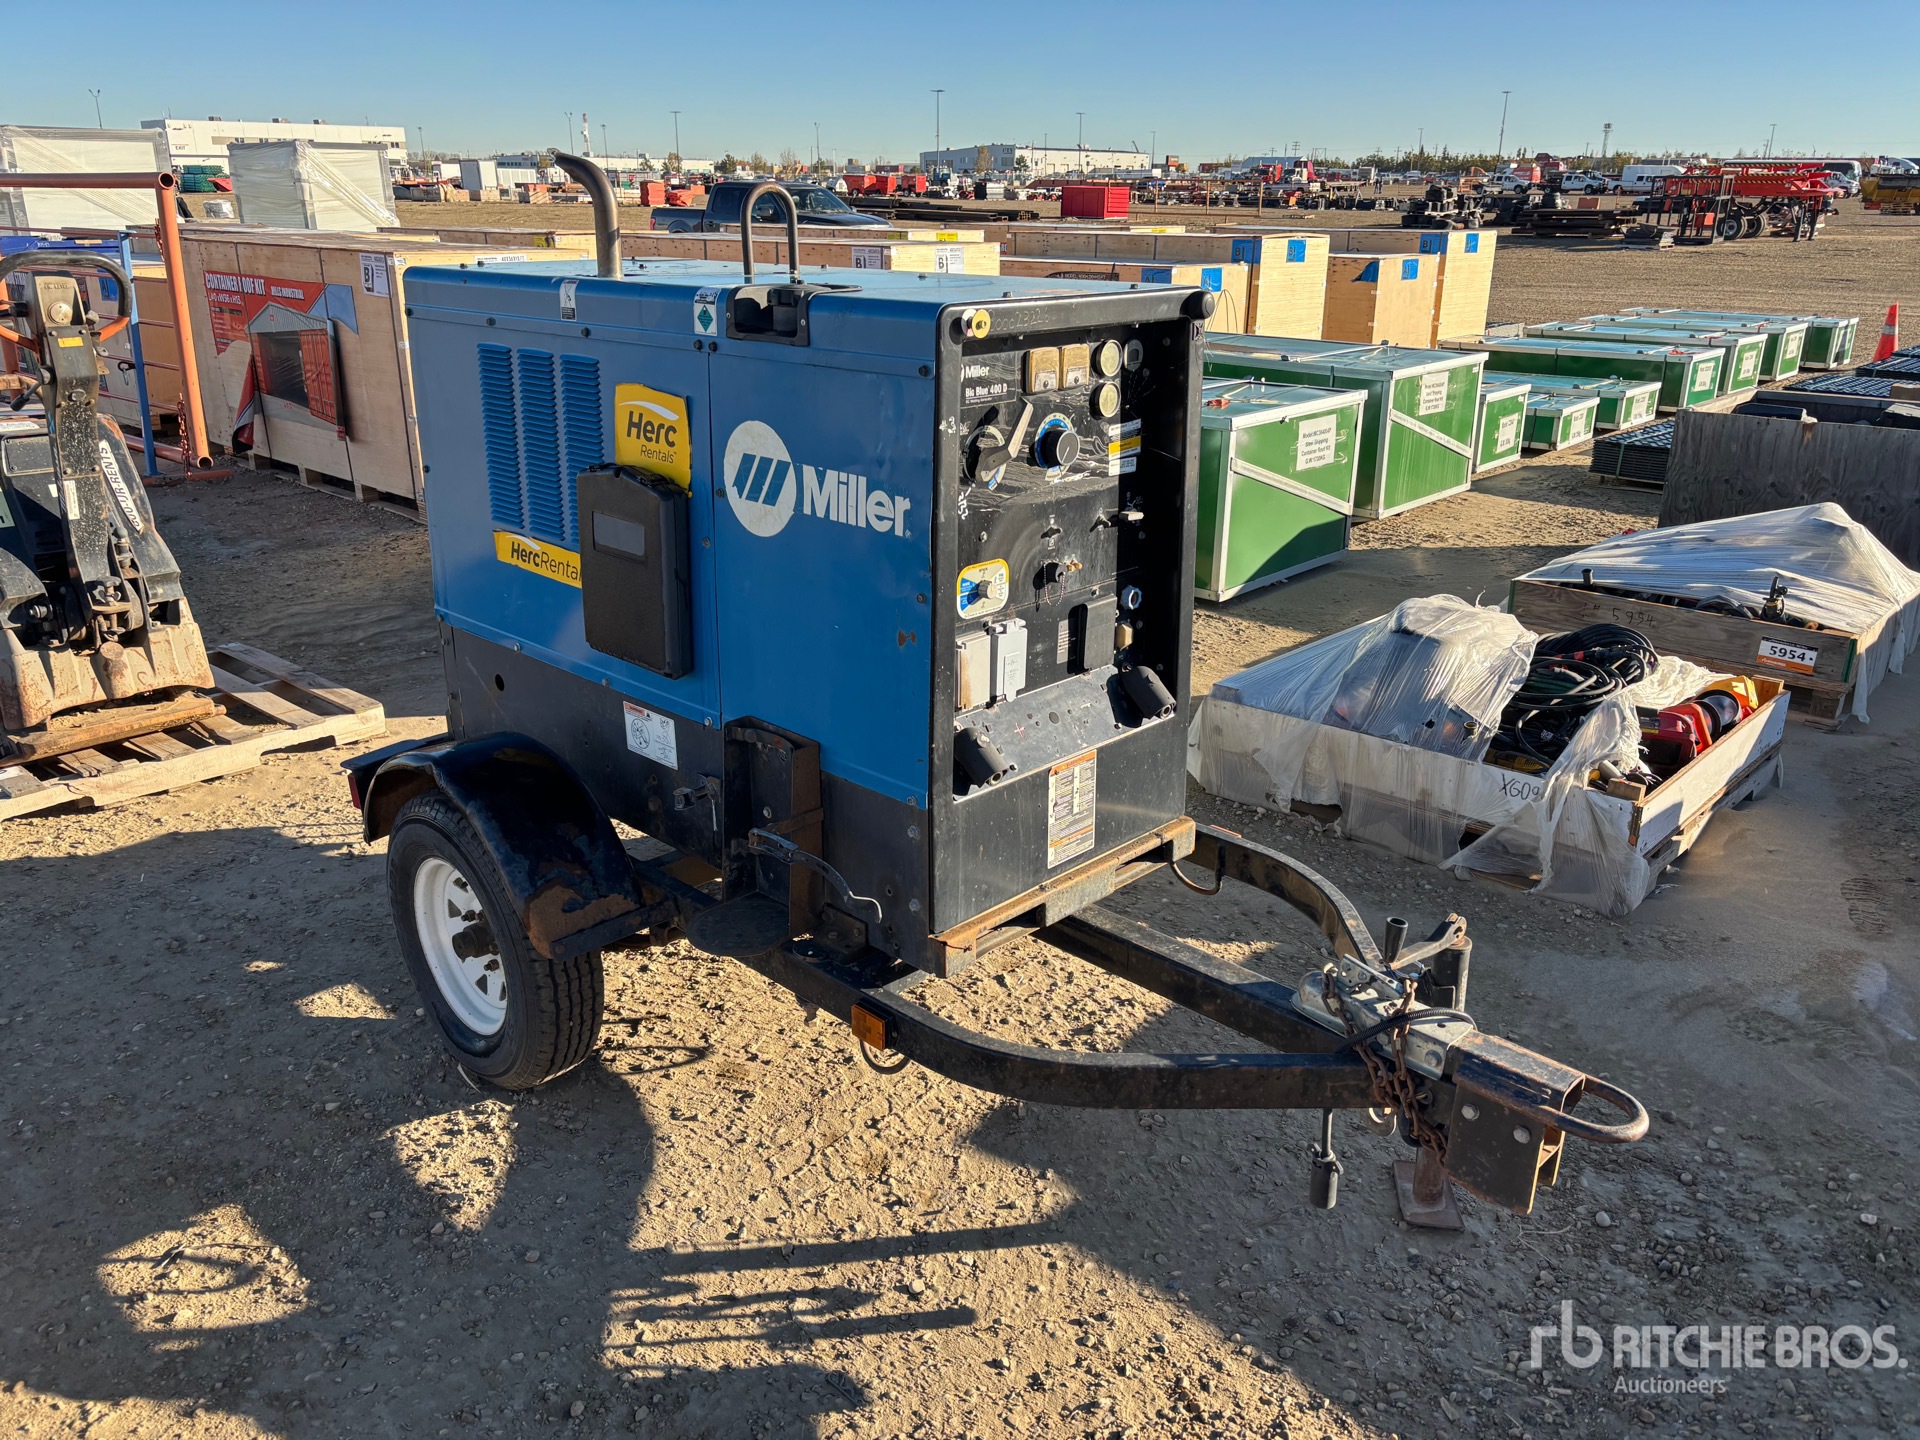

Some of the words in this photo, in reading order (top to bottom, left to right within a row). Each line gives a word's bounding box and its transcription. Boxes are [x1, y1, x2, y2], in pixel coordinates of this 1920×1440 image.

[205, 273, 238, 292] CONTAINER
[254, 279, 266, 296] KIT
[965, 365, 990, 379] Miller
[626, 410, 677, 448] Herc
[640, 444, 674, 464] Rentals
[802, 463, 911, 537] Miller
[1612, 607, 1656, 626] 5954
[1768, 645, 1807, 662] 5954
